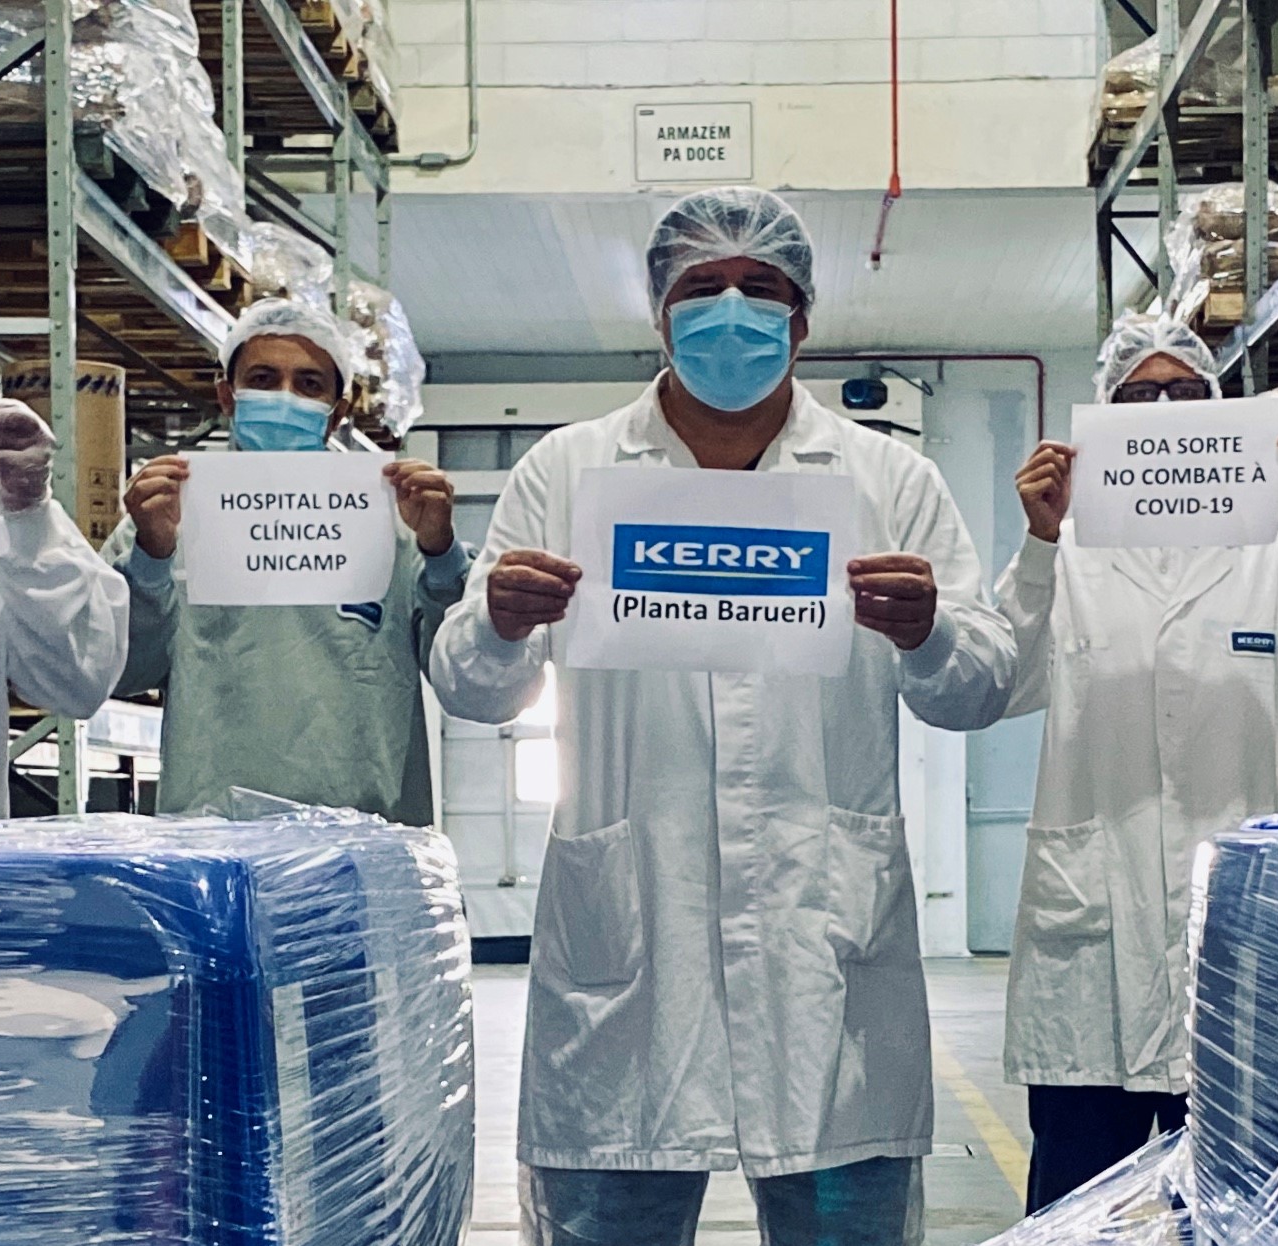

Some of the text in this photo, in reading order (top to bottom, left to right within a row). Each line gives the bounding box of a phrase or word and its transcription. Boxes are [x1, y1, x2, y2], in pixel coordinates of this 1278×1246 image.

[657, 122, 731, 140] ARMAZÉM
[664, 146, 726, 161] PA DOCE
[1127, 436, 1243, 456] BOA SORTE
[1104, 461, 1267, 486] NO COMBATE À
[221, 493, 370, 511] HOSPITAL DAS
[1135, 497, 1234, 515] COVID-19
[250, 519, 343, 541] CLÍNICAS
[246, 555, 348, 572] UNICAMP
[634, 540, 815, 570] KERRY
[613, 594, 827, 629] (Planta Barueri)
